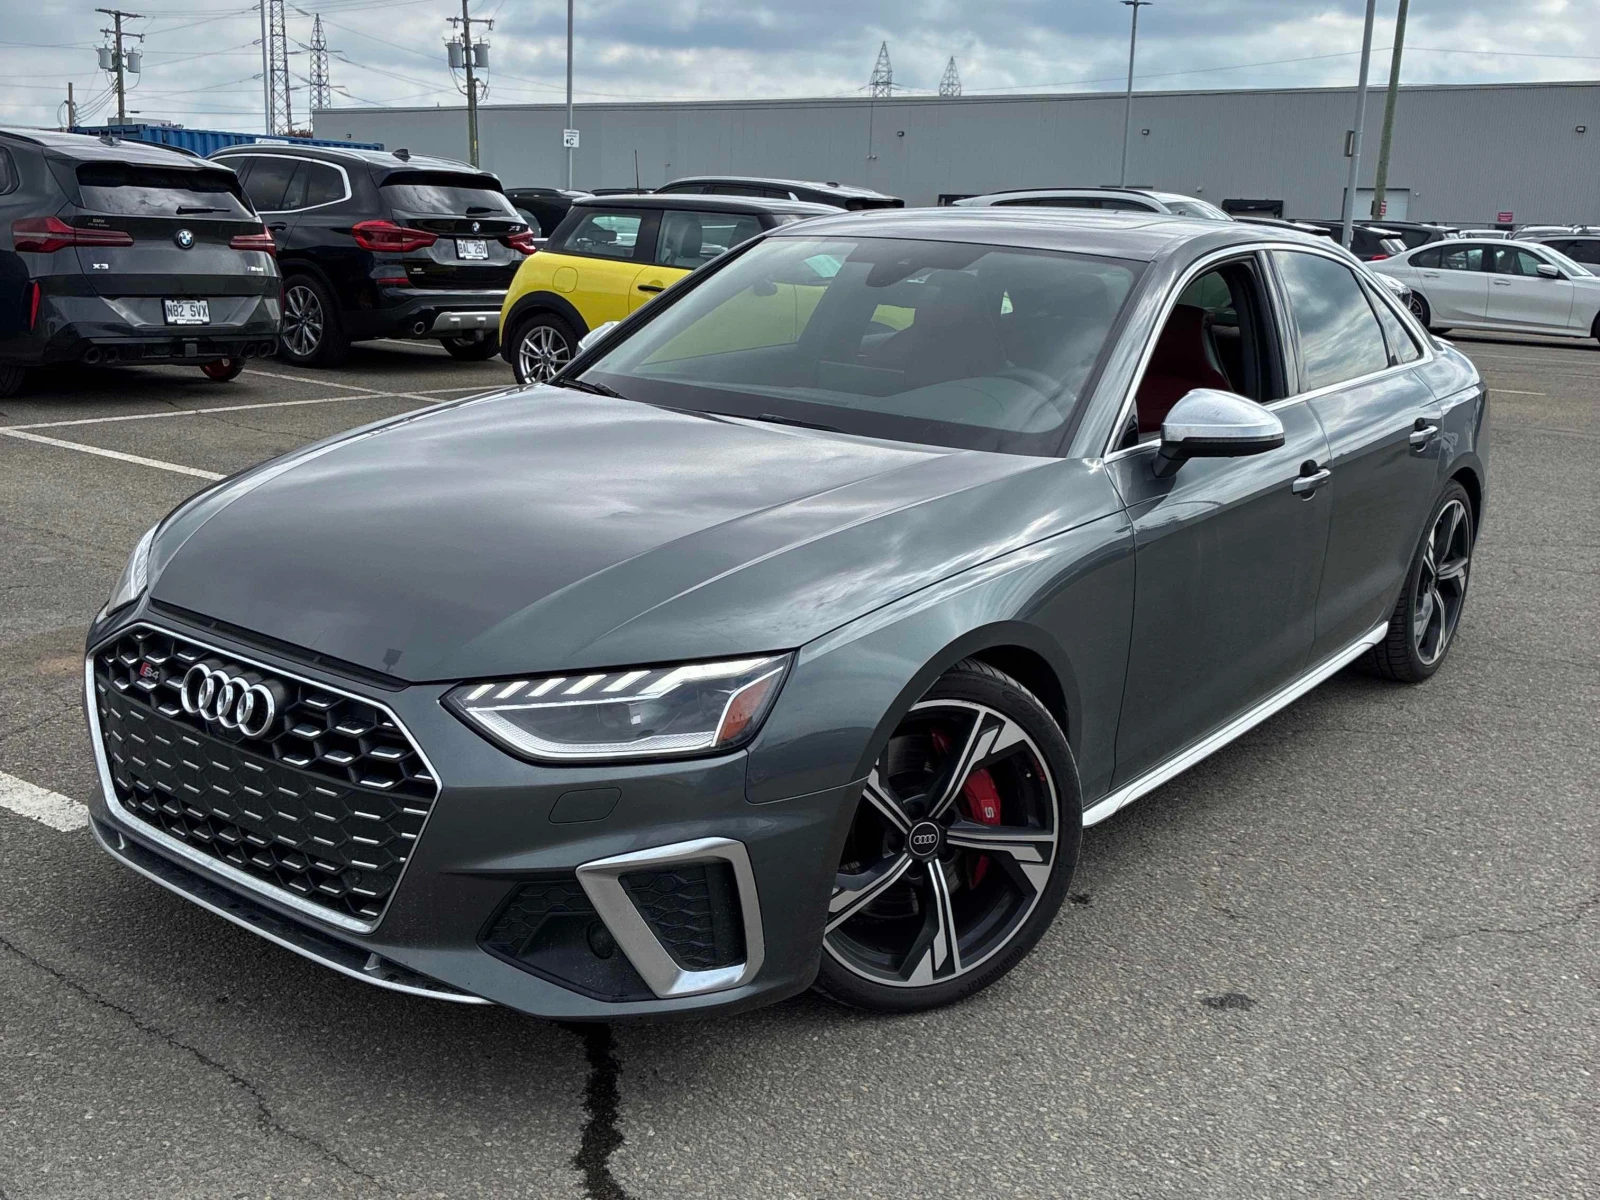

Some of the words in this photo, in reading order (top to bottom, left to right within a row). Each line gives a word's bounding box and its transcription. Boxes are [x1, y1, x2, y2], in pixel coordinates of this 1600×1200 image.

[569, 138, 575, 146] C
[166, 304, 185, 317] N82
[190, 304, 208, 318] SVX
[143, 665, 160, 680] S4
[984, 806, 995, 819] S
